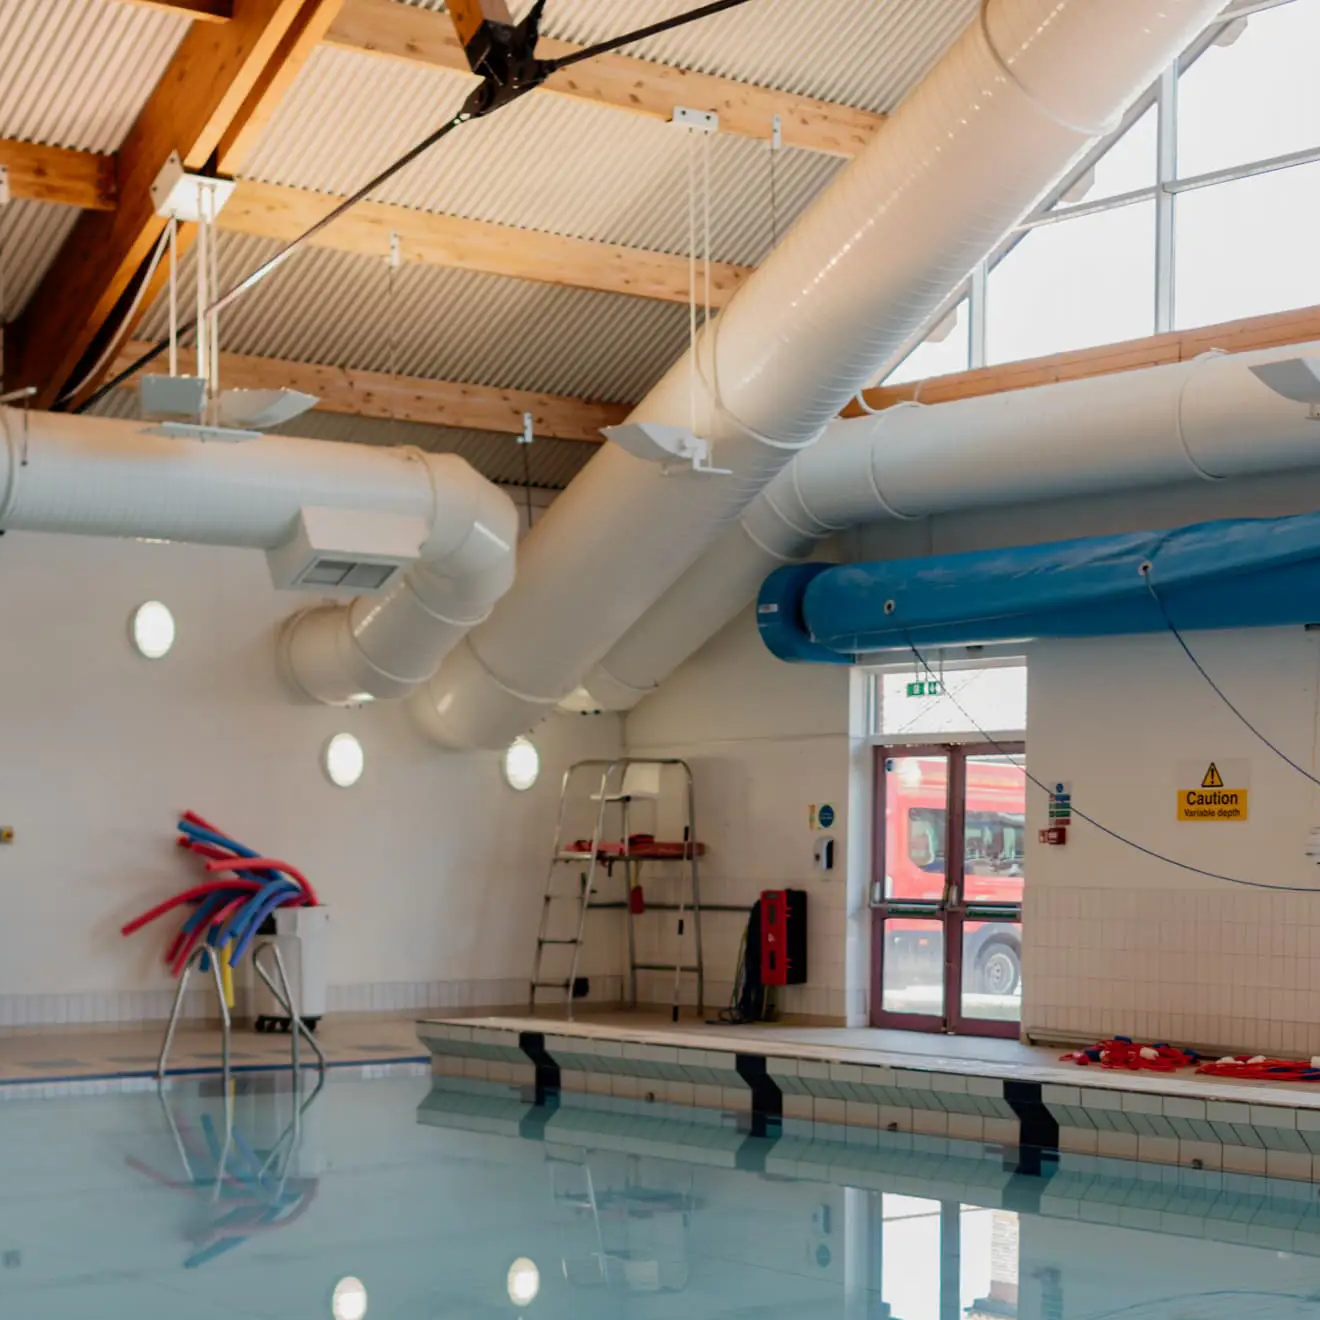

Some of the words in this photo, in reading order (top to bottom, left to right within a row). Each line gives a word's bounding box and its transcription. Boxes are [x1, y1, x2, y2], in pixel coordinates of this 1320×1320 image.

[1186, 791, 1238, 805] Caution
[1184, 808, 1215, 817] Variable
[1217, 808, 1241, 818] depth
